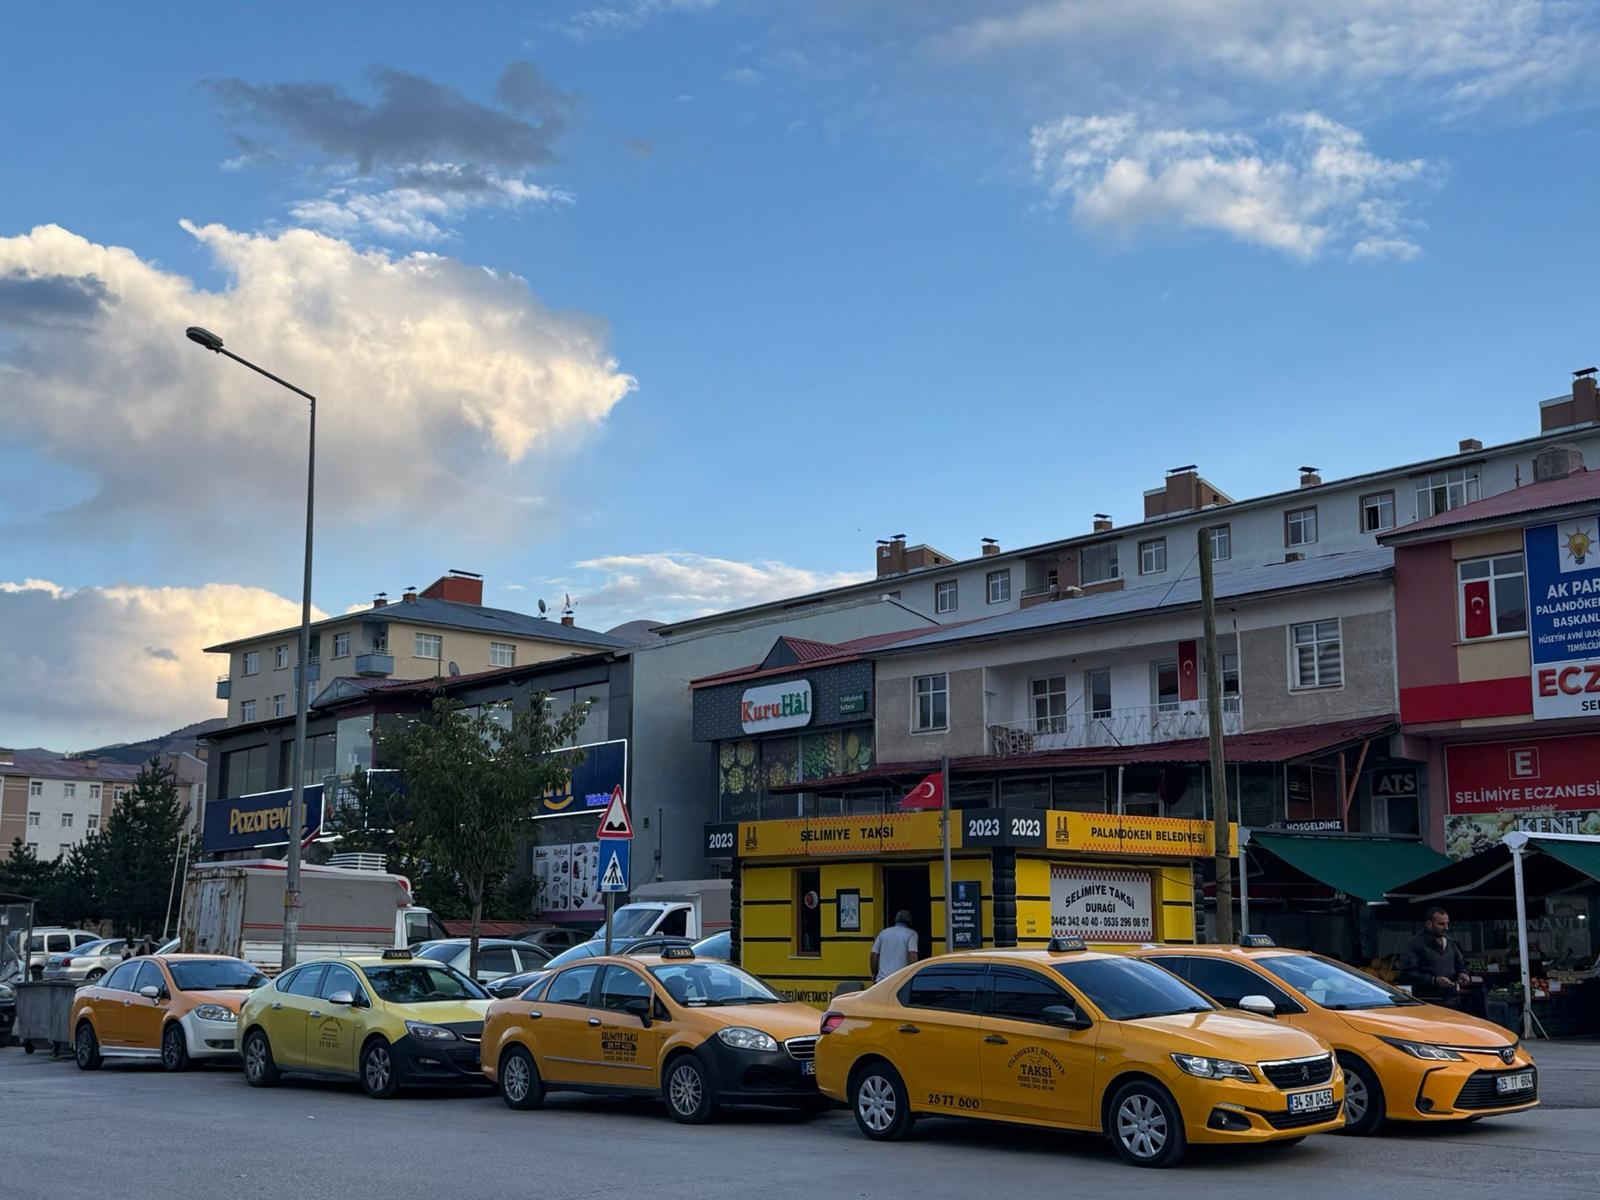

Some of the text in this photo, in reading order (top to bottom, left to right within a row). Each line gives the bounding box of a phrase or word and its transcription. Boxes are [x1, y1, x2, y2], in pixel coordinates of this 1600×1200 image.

[1547, 582, 1569, 599] AK
[1536, 597, 1600, 616] PALANDÖKE
[1539, 631, 1566, 645] HÜSEYİN
[1567, 628, 1584, 641] AVNİ
[1538, 664, 1600, 698] ECZ
[1515, 751, 1533, 776] E
[1378, 774, 1415, 793] ATS
[1455, 780, 1600, 803] SELİMİYE ECZANESİ
[800, 823, 894, 842] SELİMİYE TAKSİ
[968, 818, 1001, 837] 2023
[1012, 818, 1041, 837] 2023
[1516, 817, 1582, 834] KENT
[709, 832, 734, 849] 2023
[1091, 826, 1206, 844] PALANDÖKEN BELEDİYESİ
[1065, 882, 1135, 909] SELİMİYE TAKSİ
[1085, 901, 1116, 913] DURAĞI
[1051, 916, 1067, 926] 0442
[1068, 916, 1080, 926] 342
[1081, 917, 1089, 926] 40
[1090, 917, 1099, 926] 40
[1103, 917, 1119, 927] 0535
[1120, 917, 1132, 927] 296
[1132, 918, 1141, 927] 08
[1141, 918, 1149, 927] 97
[1020, 1063, 1052, 1078] TAKSİ
[1511, 1076, 1518, 1089] TT
[928, 1093, 941, 1104] 25
[958, 1097, 980, 1109] 600
[1293, 1095, 1303, 1109] 34
[1315, 1091, 1332, 1106] 0455
